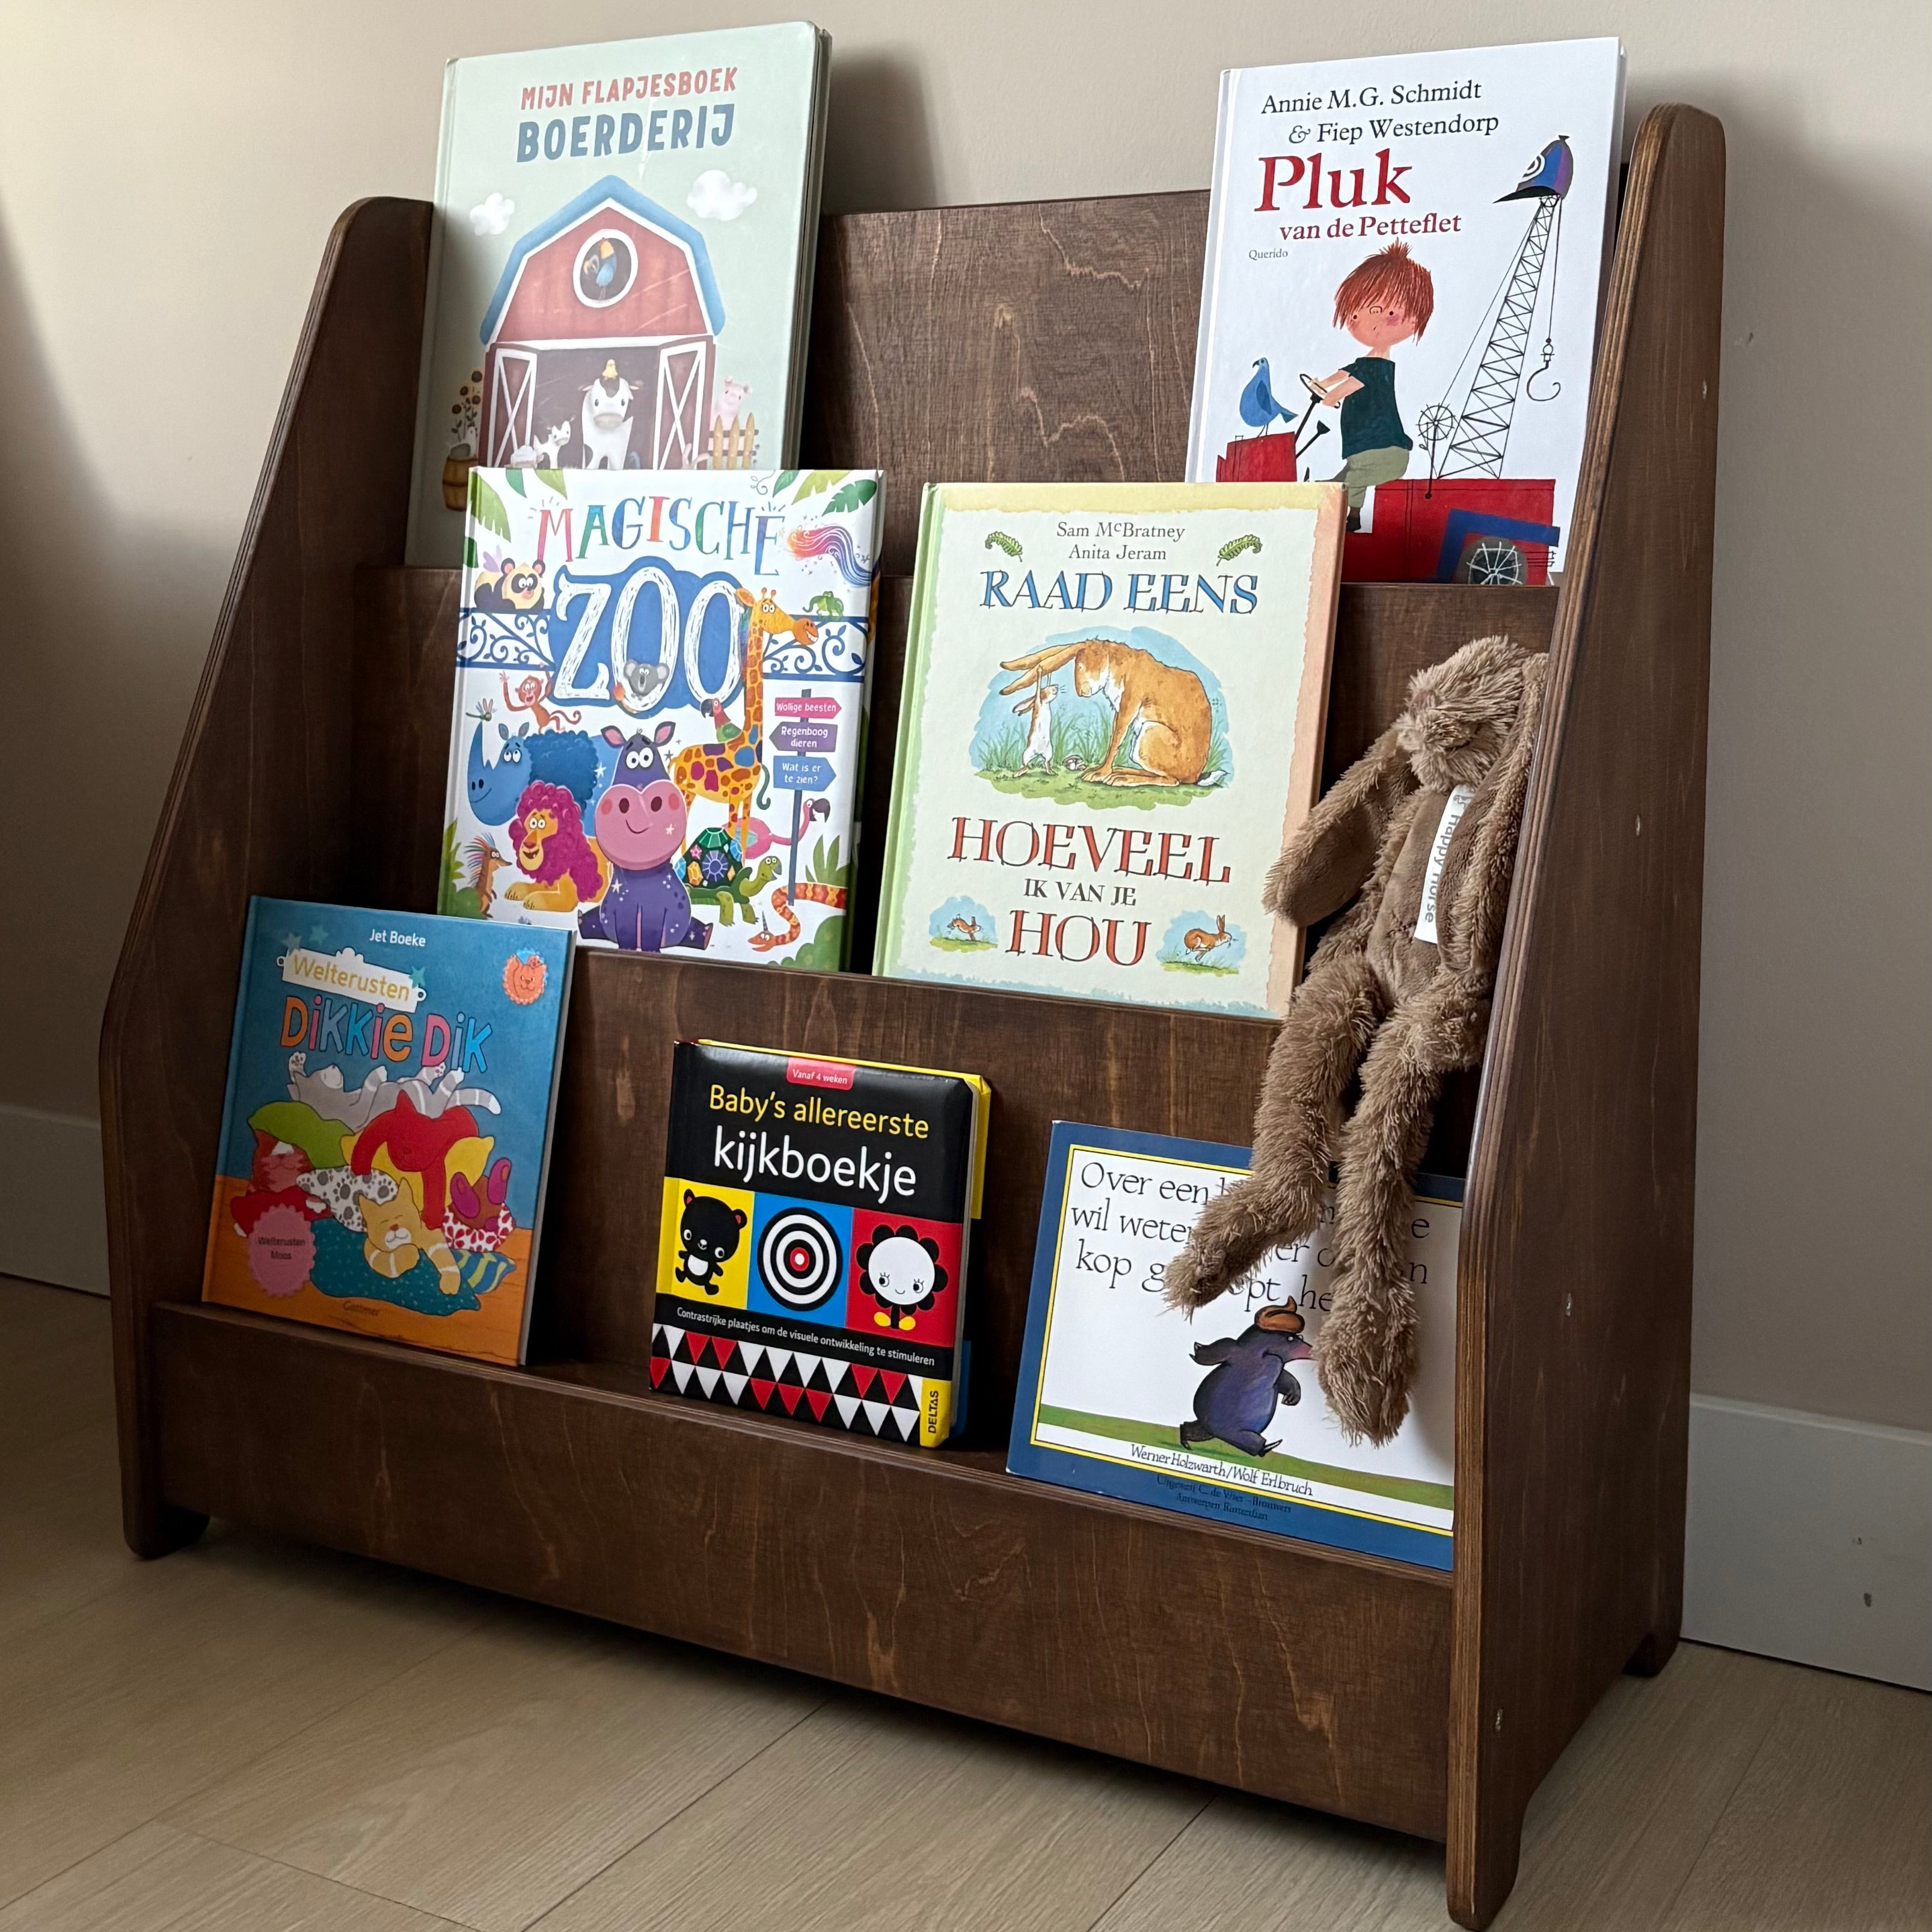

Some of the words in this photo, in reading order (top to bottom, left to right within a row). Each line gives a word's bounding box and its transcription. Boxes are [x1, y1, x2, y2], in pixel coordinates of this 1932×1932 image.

[521, 82, 574, 111] MIJN
[581, 67, 738, 105] FLAPJESBOEK
[1260, 92, 1323, 114] Annie
[1327, 87, 1384, 109] M.G.
[1391, 80, 1482, 105] Schmidt
[516, 103, 735, 163] BOERDERIJ
[1289, 125, 1311, 144] &
[1317, 122, 1363, 145] Fiep
[1369, 113, 1499, 140] Westendorp
[1254, 148, 1412, 212] Pluk
[1280, 222, 1320, 241] van
[1326, 217, 1354, 238] de
[1359, 213, 1462, 236] Petteflet
[1248, 248, 1289, 261] Querido
[537, 496, 785, 576] MAGISCHE
[1056, 521, 1089, 538] Sam
[1095, 521, 1185, 542] McBratney
[1069, 544, 1110, 560] Anita
[1115, 545, 1167, 560] Jeram
[980, 569, 1113, 613] RAAD
[1123, 573, 1258, 615] EENS
[553, 566, 744, 713] ZOO
[776, 703, 802, 713] Wollige
[805, 703, 836, 712] beesten
[781, 726, 828, 738] Regenboog
[791, 738, 817, 748] dieren
[782, 762, 799, 771] Wat
[802, 764, 809, 772] is
[784, 774, 793, 783] te
[796, 776, 818, 784] zien?
[947, 817, 1231, 886] HOEVEEL
[1023, 878, 1048, 898] IK
[1055, 882, 1105, 903] VAN
[1111, 886, 1136, 906] JE
[369, 929, 387, 943] Jet
[390, 930, 426, 947] Boeke
[1005, 910, 1152, 966] HOU
[293, 954, 409, 1001] Welterusten
[793, 1069, 815, 1079] Vanaf
[823, 1074, 848, 1084] weken
[710, 1084, 785, 1122] Baby's
[793, 1096, 929, 1139] allereerste
[714, 1125, 917, 1204] kijkboekje
[1081, 1162, 1153, 1195] Over
[1159, 1180, 1209, 1205] een
[1071, 1197, 1110, 1231] wil
[1076, 1238, 1132, 1289] kop
[677, 1307, 726, 1326] Contrastrijke
[728, 1318, 760, 1332] plaatjes
[762, 1326, 775, 1335] om
[777, 1327, 788, 1337] de
[790, 1330, 819, 1343] visuele
[820, 1336, 874, 1356] ontwikkeling
[876, 1346, 886, 1356] te
[888, 1349, 935, 1366] stimuleren
[928, 1390, 939, 1434] DELTAS
[1130, 1444, 1171, 1464] Werner
[1263, 1473, 1314, 1497] Erlbruch
